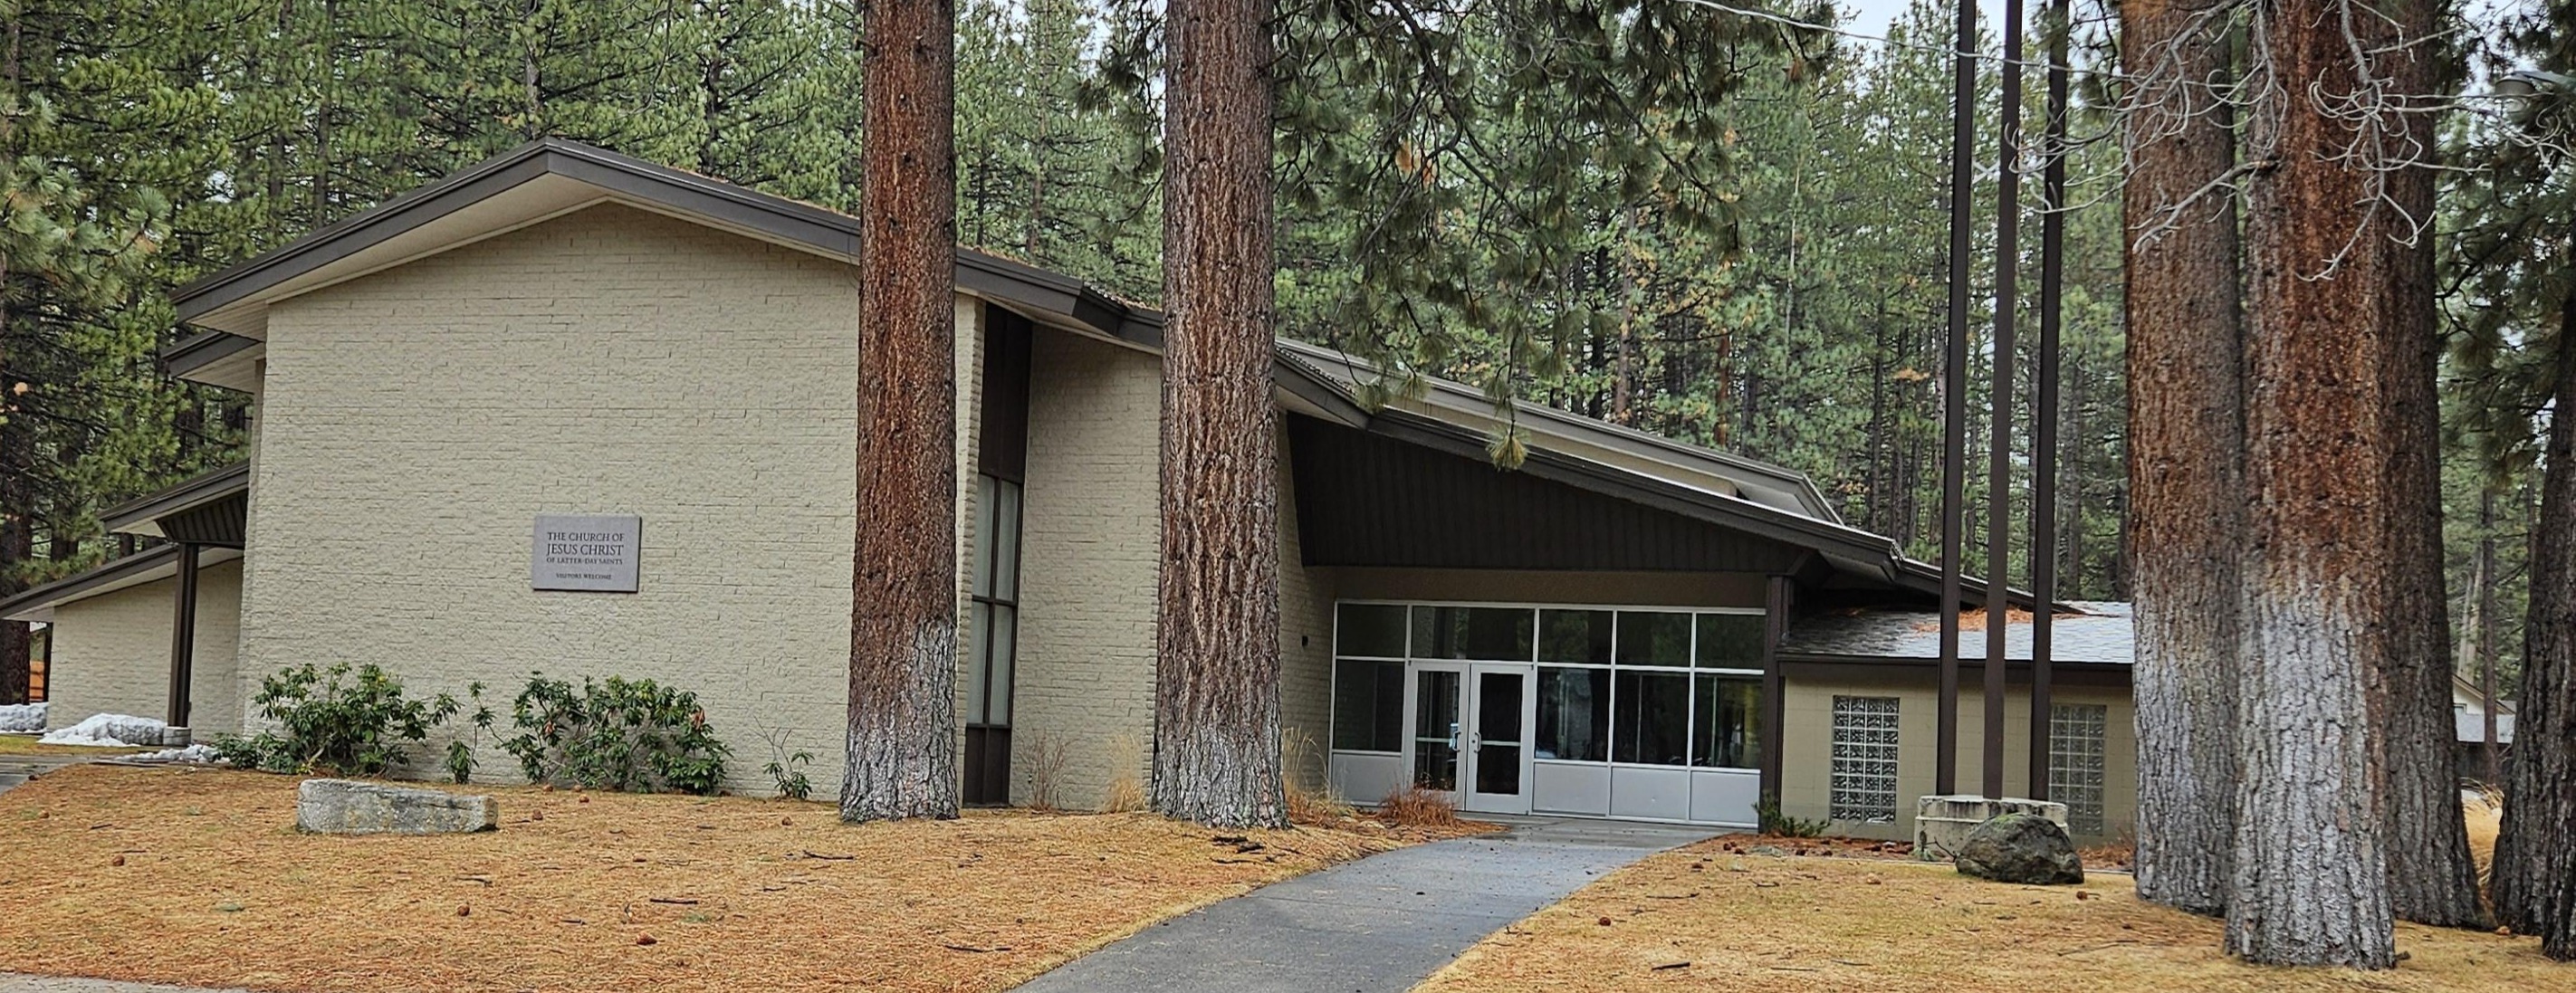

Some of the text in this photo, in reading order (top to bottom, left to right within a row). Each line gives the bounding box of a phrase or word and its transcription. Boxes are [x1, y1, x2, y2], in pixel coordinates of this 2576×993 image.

[547, 531, 625, 542] THE CHURCH OF
[547, 543, 624, 556] JESUS CHRIST
[557, 557, 598, 565] LATTER-DAY
